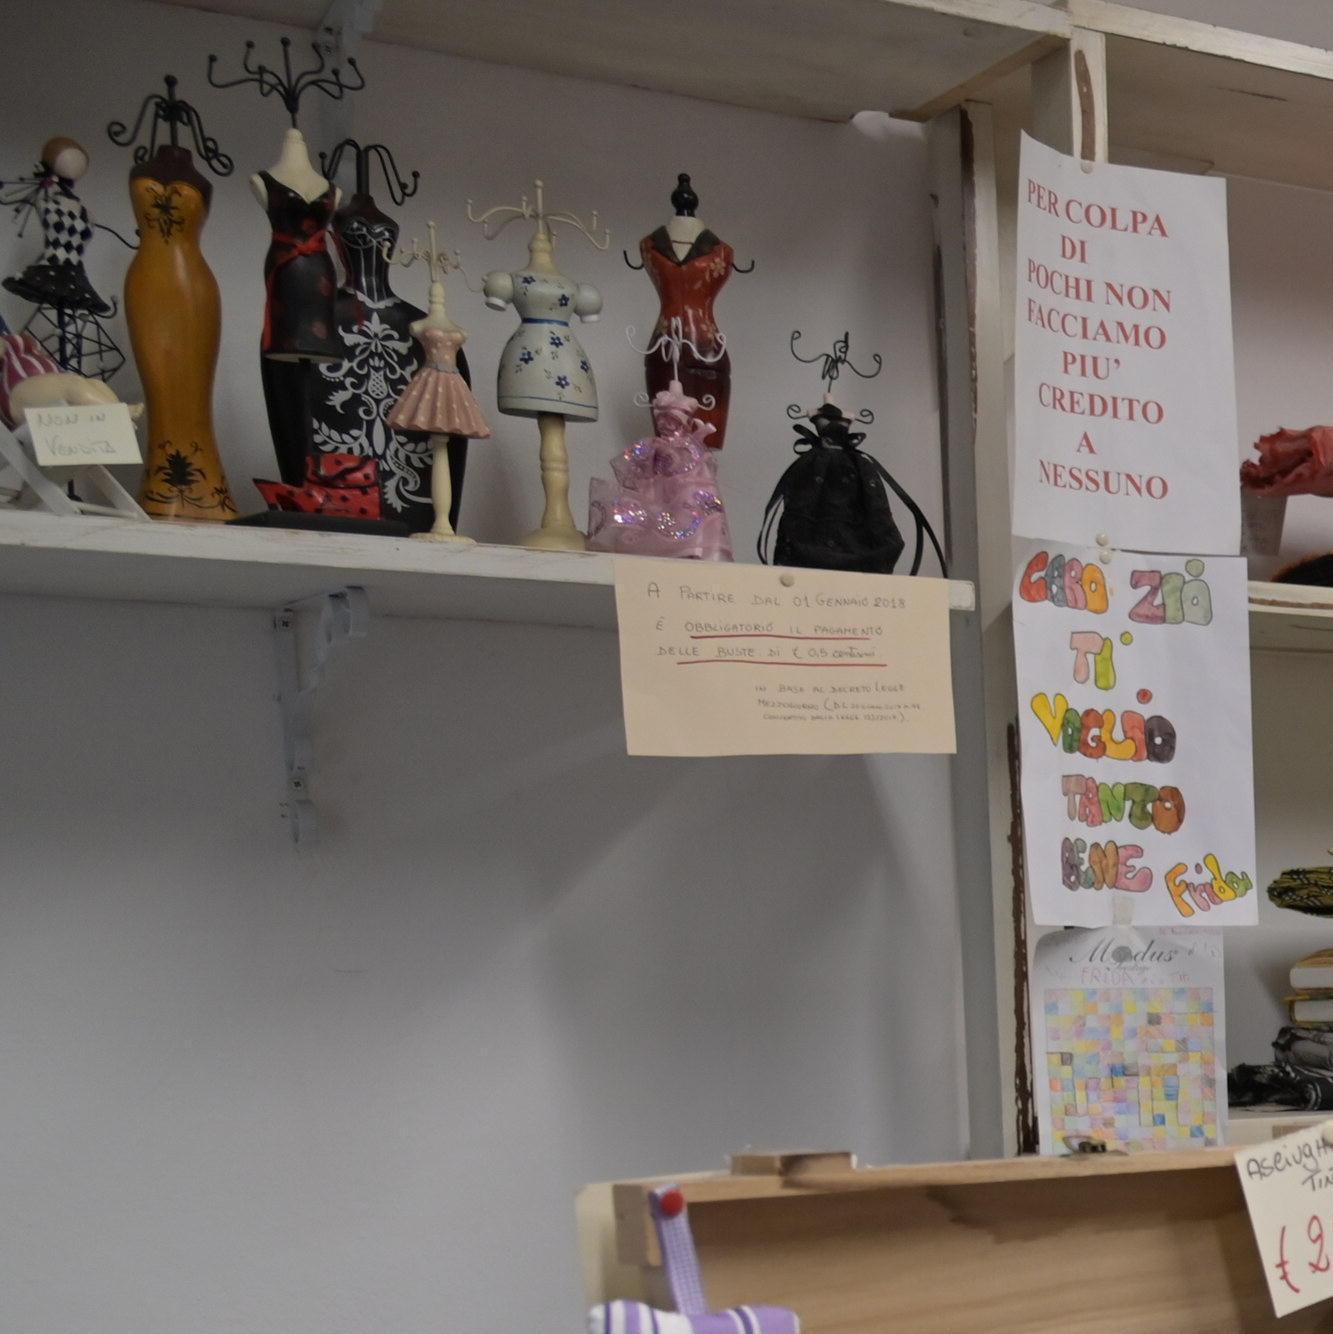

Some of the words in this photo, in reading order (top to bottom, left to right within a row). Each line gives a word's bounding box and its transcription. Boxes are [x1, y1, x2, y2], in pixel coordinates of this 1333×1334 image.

[1027, 179, 1059, 218] PER
[1065, 199, 1169, 238] COLPA
[1060, 234, 1088, 264] DI
[1027, 258, 1095, 302] POCHI
[1104, 281, 1172, 313] NON
[1027, 298, 1168, 350] FACCIAMO
[1062, 350, 1121, 381] PIU'
[1038, 382, 1165, 425] CREDITO
[1076, 431, 1098, 455] A
[1038, 459, 1169, 500] NESSUNO
[648, 582, 661, 598] A
[750, 595, 782, 608] DAL
[657, 646, 700, 657] DELLE
[715, 646, 756, 658] BUSTE
[1061, 774, 1186, 834] TANTO
[1060, 837, 1154, 893] BENE
